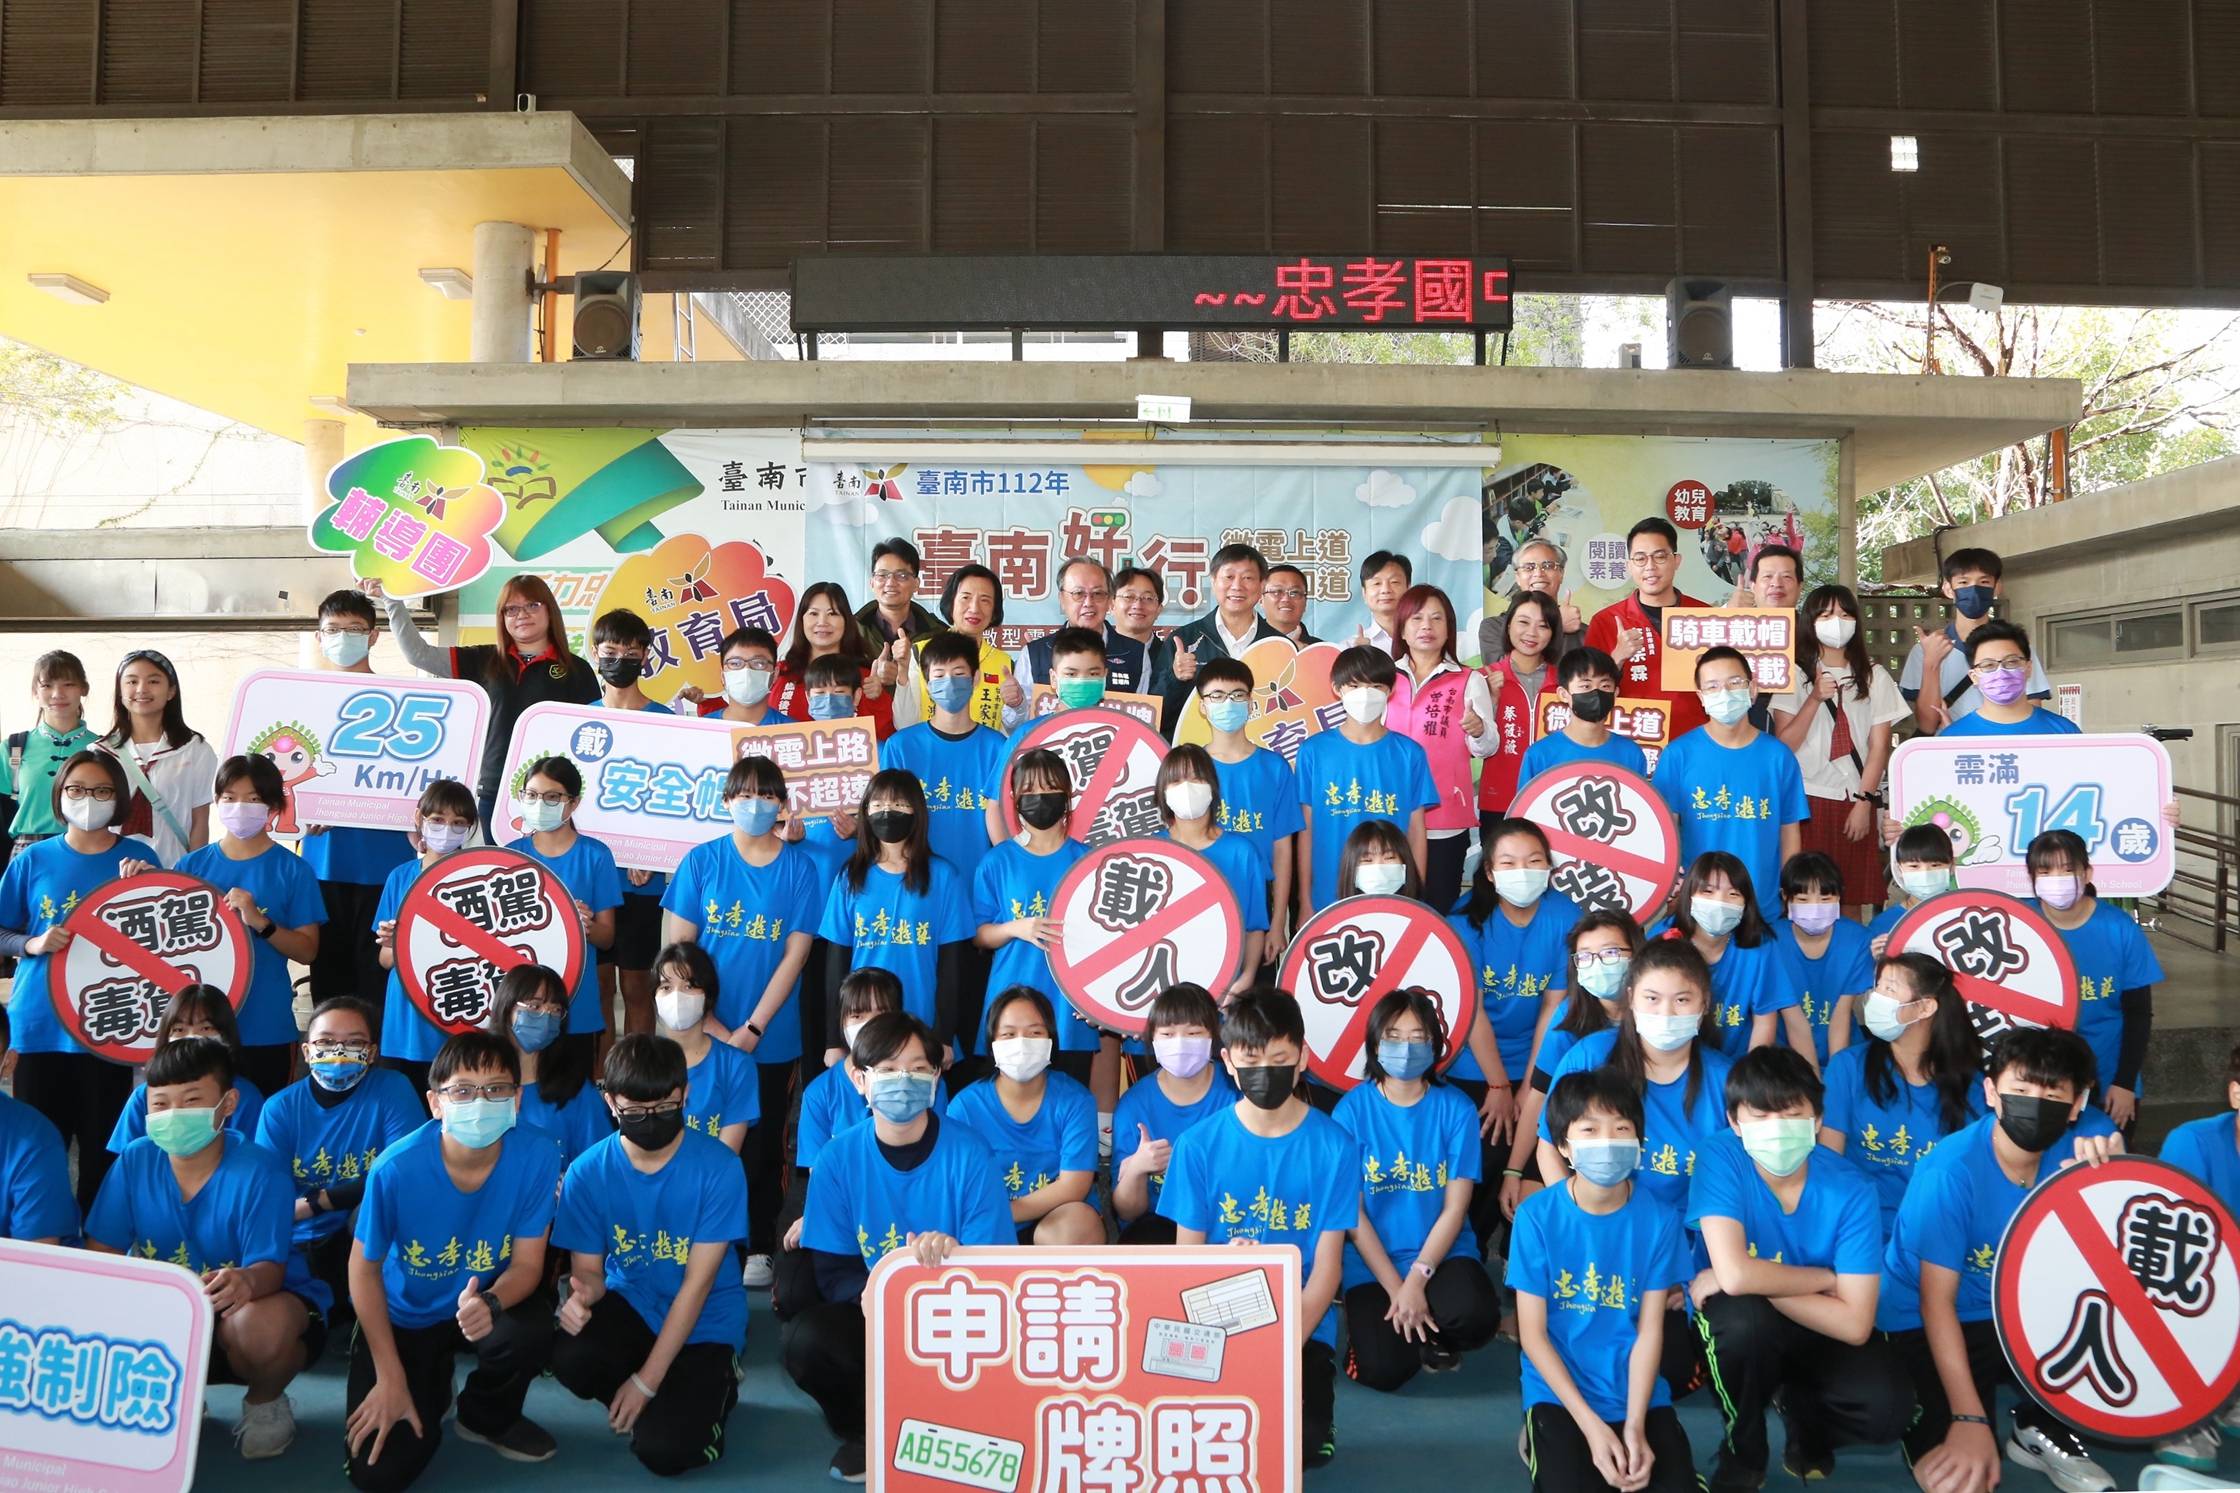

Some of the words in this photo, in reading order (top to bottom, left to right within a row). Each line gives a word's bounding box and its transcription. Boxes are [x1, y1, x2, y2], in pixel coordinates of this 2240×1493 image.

[721, 499, 762, 511] Tainan
[916, 469, 1070, 497] 臺南市112年
[1673, 488, 1707, 505] 幼兒
[331, 487, 472, 586] 輔導團
[1673, 506, 1707, 522] 教育
[1588, 540, 1628, 560] 閱讀
[1588, 561, 1627, 580] 素養
[1669, 618, 1788, 648] 騎車戴帽
[329, 691, 451, 761] 25
[575, 726, 608, 758] 戴
[1954, 753, 2020, 785] 需滿
[1559, 782, 1629, 839] 改
[2007, 784, 2105, 857] 14
[2117, 823, 2152, 855] 歲
[1097, 861, 1164, 925] 載
[1313, 933, 1377, 998] 改
[1942, 914, 2020, 978] 改
[1124, 947, 1181, 1002] 人
[2127, 1205, 2209, 1304] 載
[917, 1280, 1116, 1379] 申請
[2047, 1302, 2126, 1393] 人
[4, 1455, 67, 1478] Municipal
[899, 1430, 1021, 1484] AB55678
[1046, 1406, 1250, 1493] 牌照
